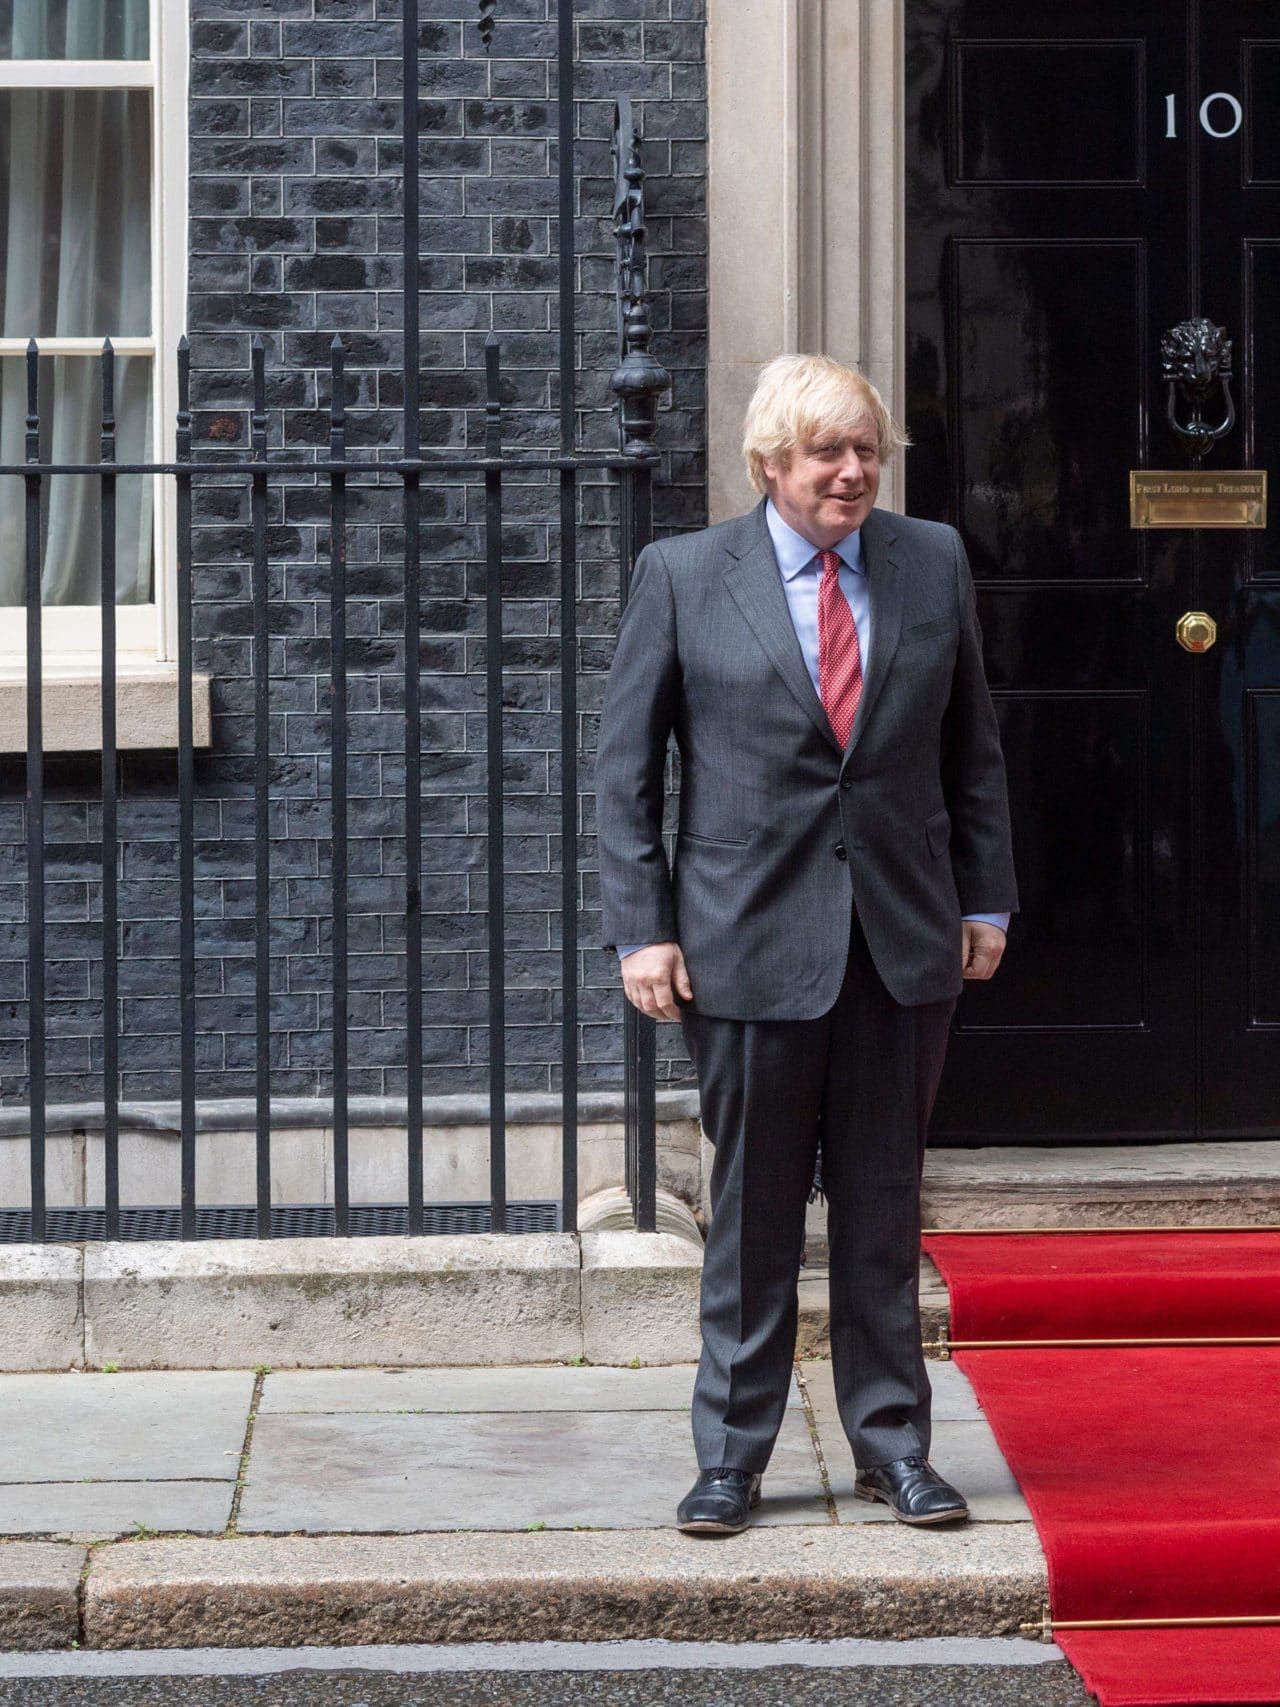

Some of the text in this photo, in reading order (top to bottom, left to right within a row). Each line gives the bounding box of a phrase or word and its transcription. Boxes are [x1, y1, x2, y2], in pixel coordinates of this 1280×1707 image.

[1165, 92, 1242, 138] 10
[1164, 483, 1190, 494] LORD
[1216, 483, 1263, 494] TREASURY
